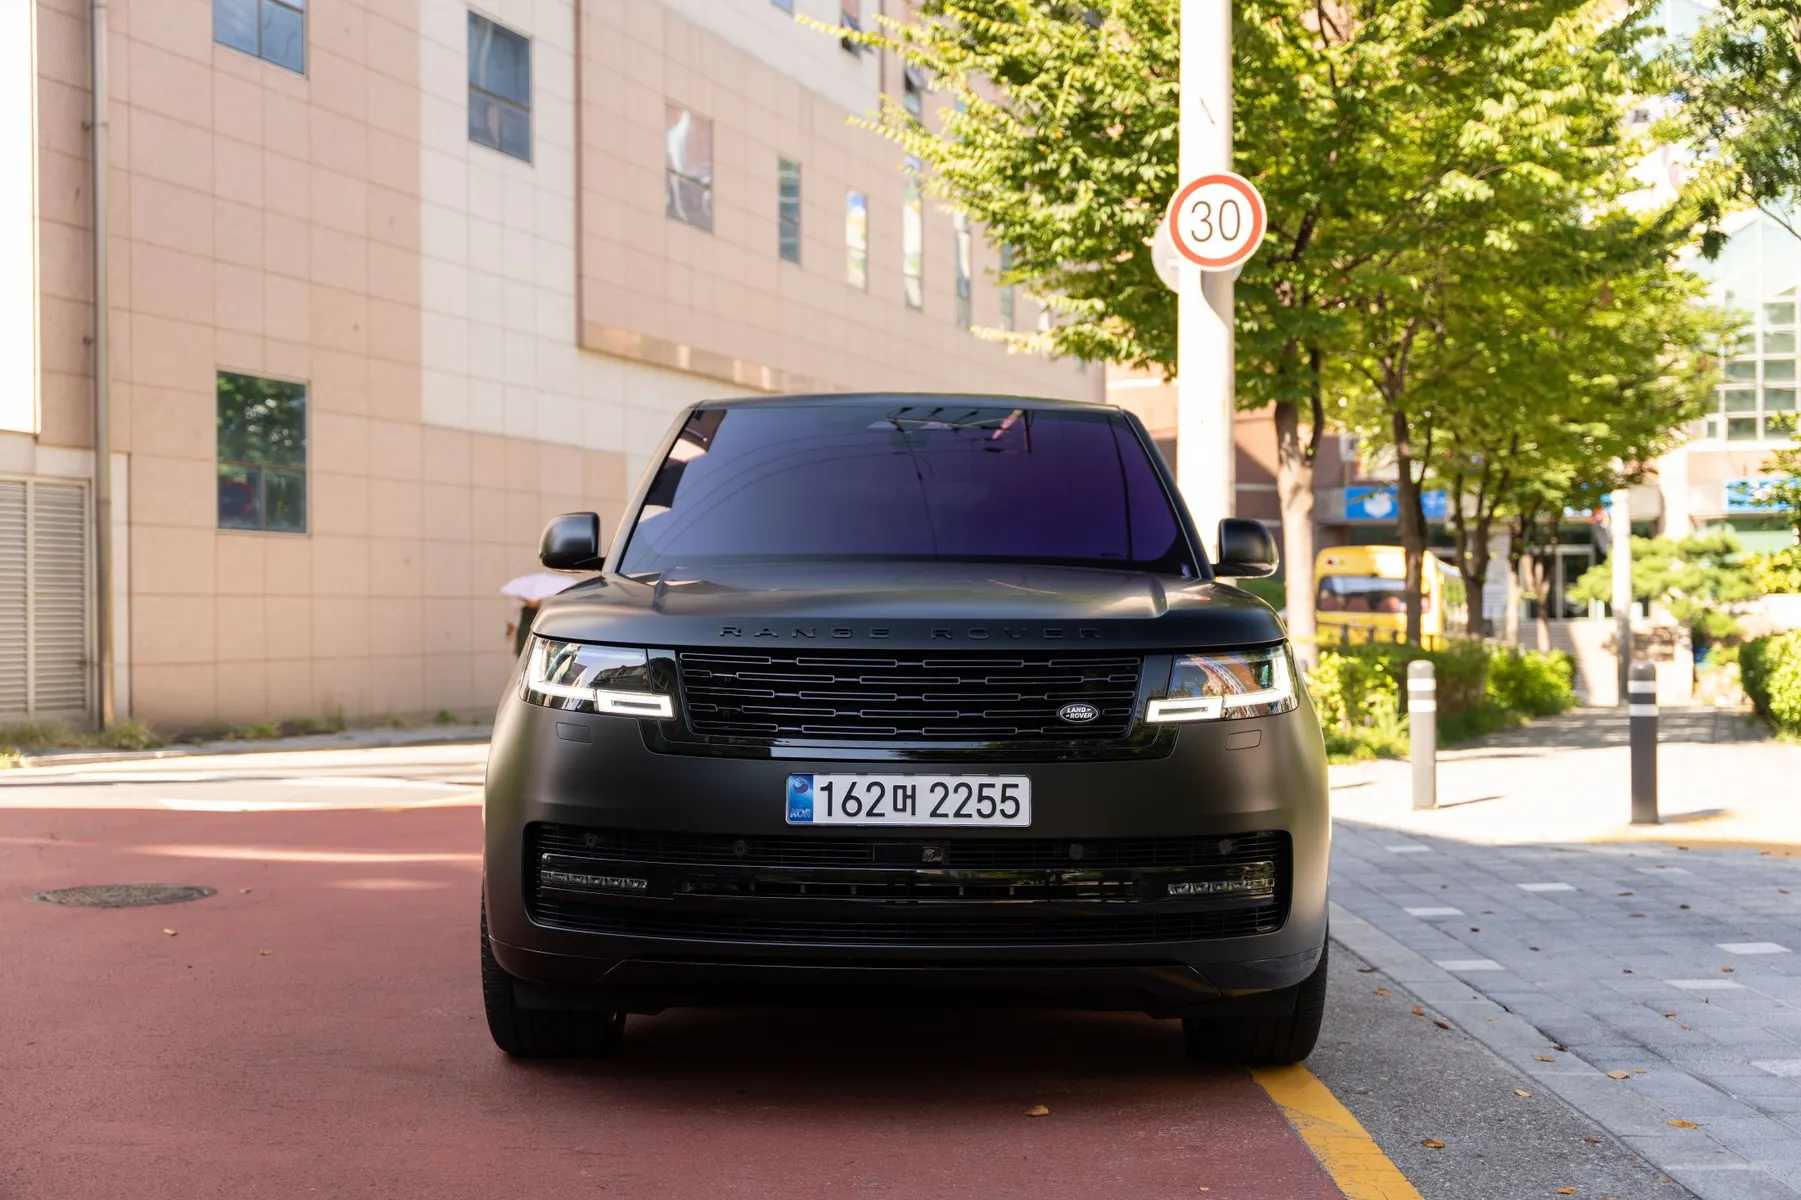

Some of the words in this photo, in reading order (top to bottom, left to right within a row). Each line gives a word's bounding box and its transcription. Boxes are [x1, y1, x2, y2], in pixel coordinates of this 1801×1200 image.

[1191, 199, 1240, 242] 30
[719, 625, 890, 639] RANGE
[930, 626, 1103, 640] ROVER
[790, 808, 811, 818] KOR
[819, 780, 917, 818] 162머
[929, 781, 1020, 819] 2255
